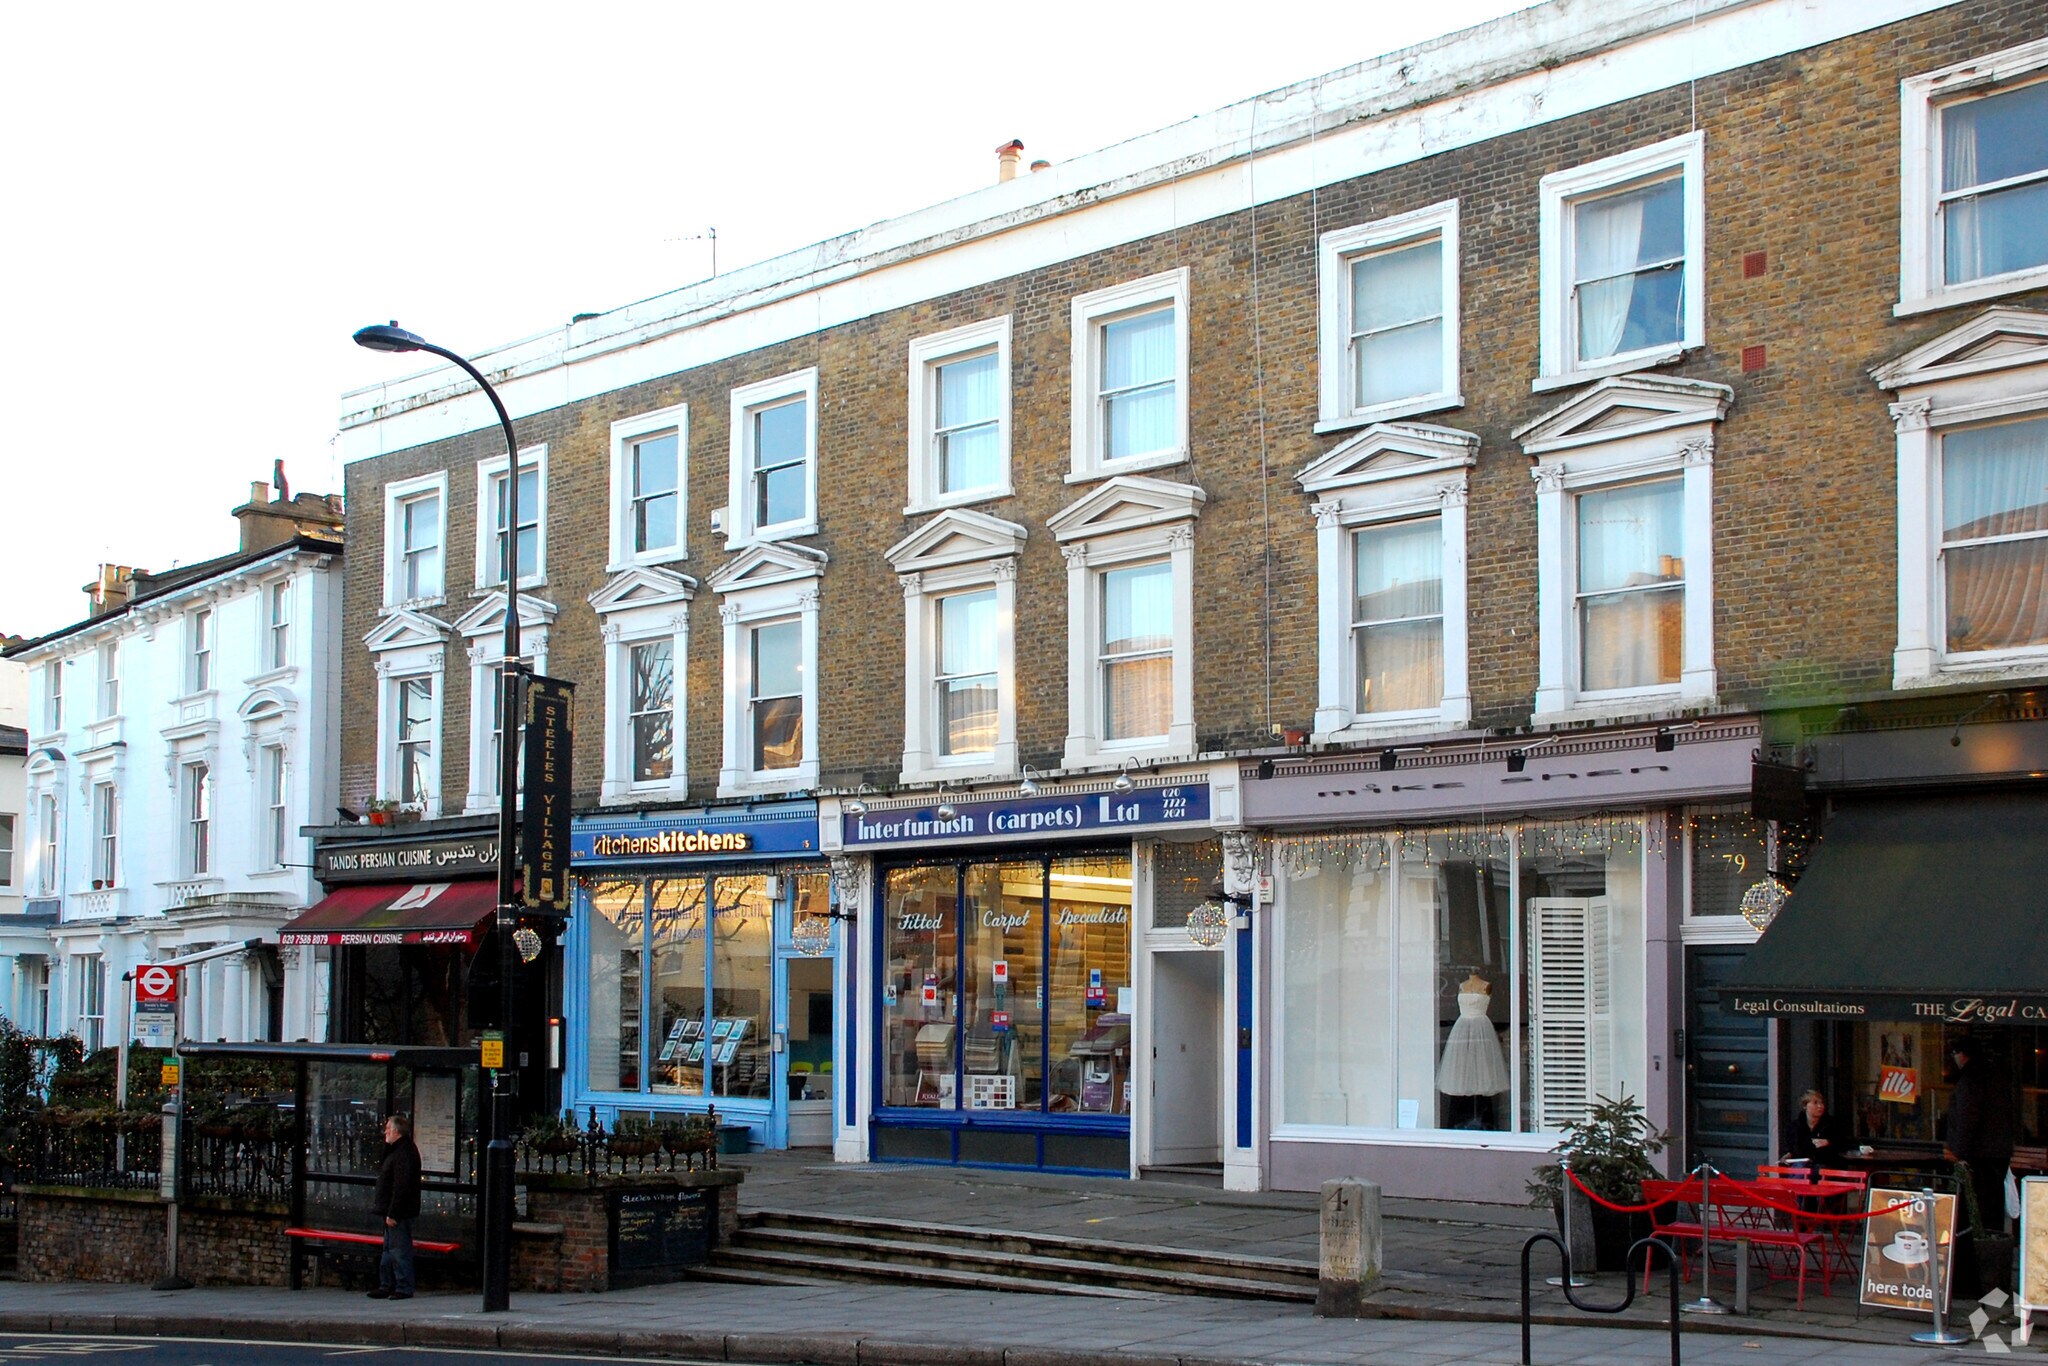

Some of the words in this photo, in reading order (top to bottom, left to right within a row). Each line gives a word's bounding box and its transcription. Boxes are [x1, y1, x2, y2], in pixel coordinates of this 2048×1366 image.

[544, 705, 556, 783] STEELES
[1162, 788, 1180, 798] 020
[1163, 798, 1186, 808] 7722
[988, 805, 1082, 834] (carpets)
[1099, 796, 1140, 823] Ltd
[1163, 808, 1185, 818] 2021
[542, 794, 554, 872] VILLAGE
[593, 830, 747, 855] kitchenskitchens
[329, 855, 359, 870] TANDIS
[360, 852, 396, 869] PERSIAN
[398, 849, 432, 866] CUISINE
[436, 844, 476, 865] تندیس
[1722, 854, 1745, 874] 79
[1184, 877, 1198, 893] 77
[898, 913, 943, 930] Fitted
[983, 910, 1031, 934] Carpet
[1053, 906, 1128, 929] Specialists
[282, 935, 294, 944] 020
[341, 934, 371, 944] PERSIAN
[373, 933, 403, 944] CUISINE
[1735, 998, 1769, 1014] Legal
[1773, 999, 1864, 1014] Consultations
[1912, 1002, 1944, 1015] THE
[1942, 999, 2015, 1022] Legal
[1882, 1072, 1914, 1098] illy
[1328, 1187, 1348, 1212] 4
[1888, 1195, 1936, 1218] enjo
[1867, 1279, 1899, 1296] here
[1902, 1283, 1933, 1300] toda
